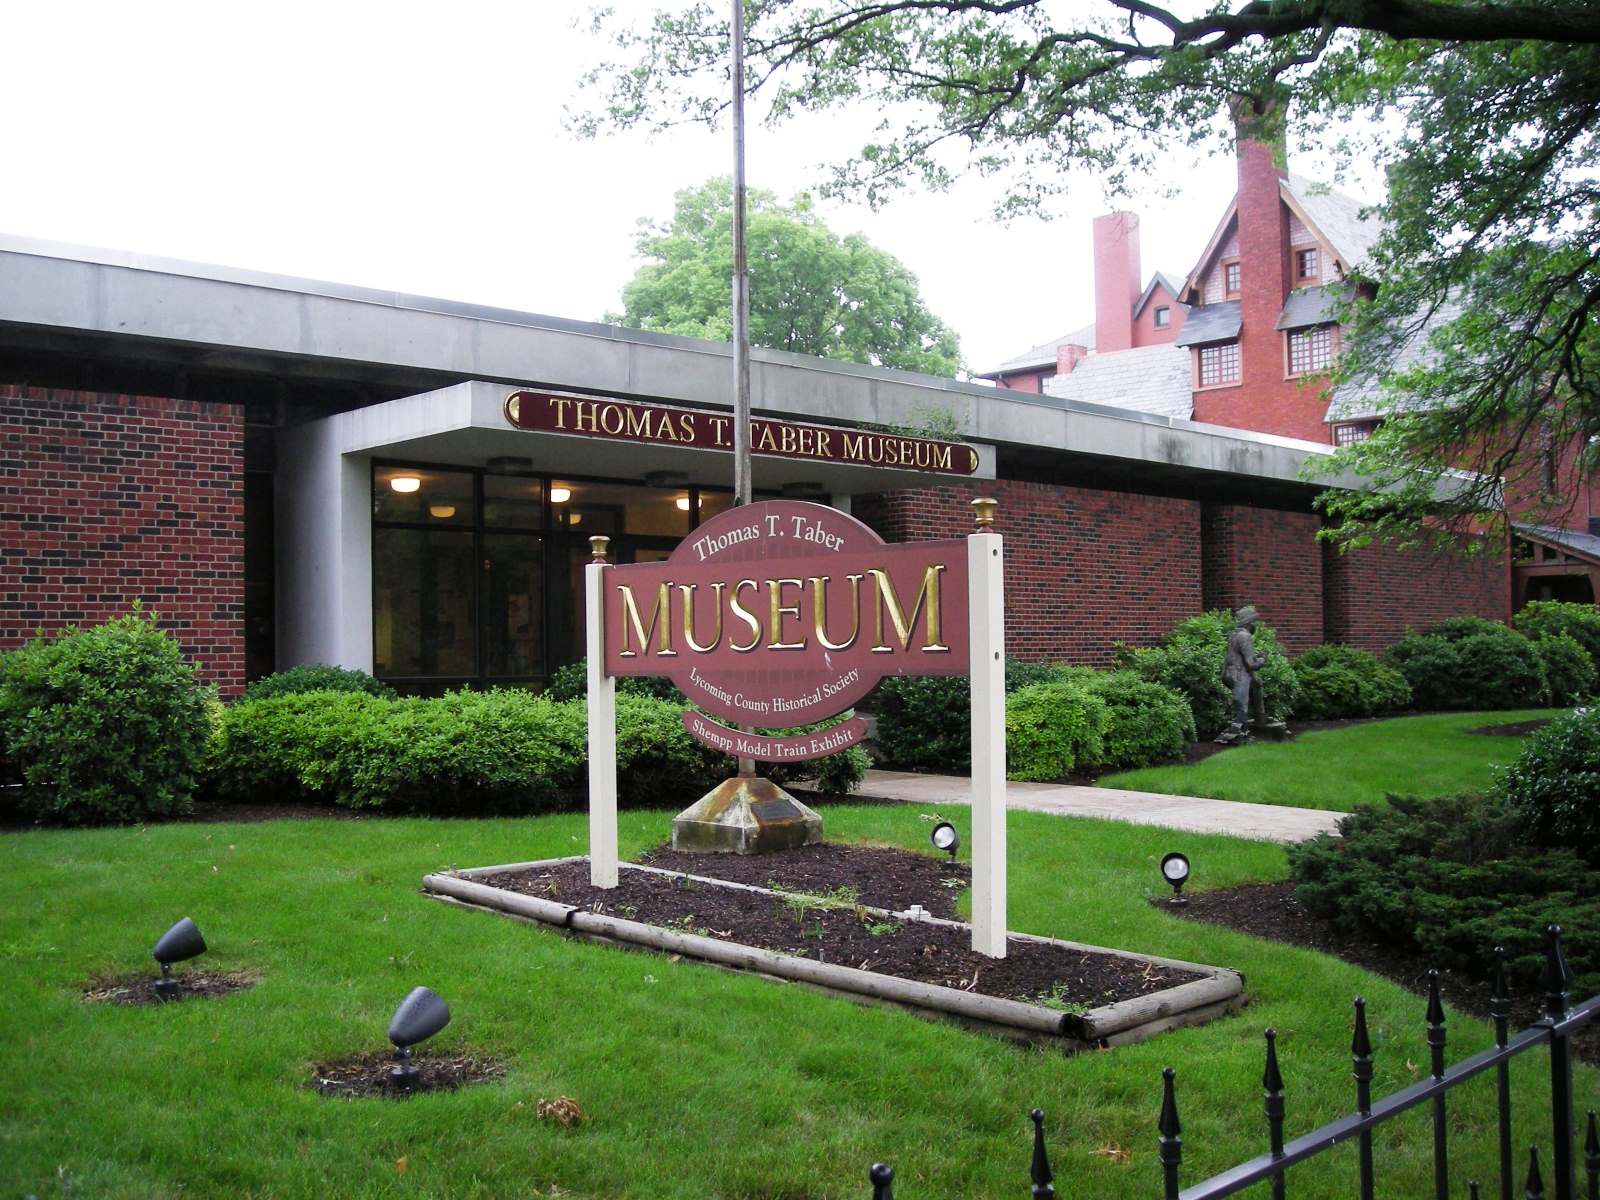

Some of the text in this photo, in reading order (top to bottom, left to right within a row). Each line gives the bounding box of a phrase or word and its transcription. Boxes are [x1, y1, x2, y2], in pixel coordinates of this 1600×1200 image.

[549, 398, 696, 443] THOMAS
[708, 417, 732, 446] T.
[842, 433, 953, 470] MUSEUM
[692, 514, 845, 562] Thomas T. Taber
[617, 565, 949, 656] MUSEUM
[689, 667, 860, 715] Lycoming County Historical Society
[692, 719, 854, 757] Shempp Model Train Exhibit
